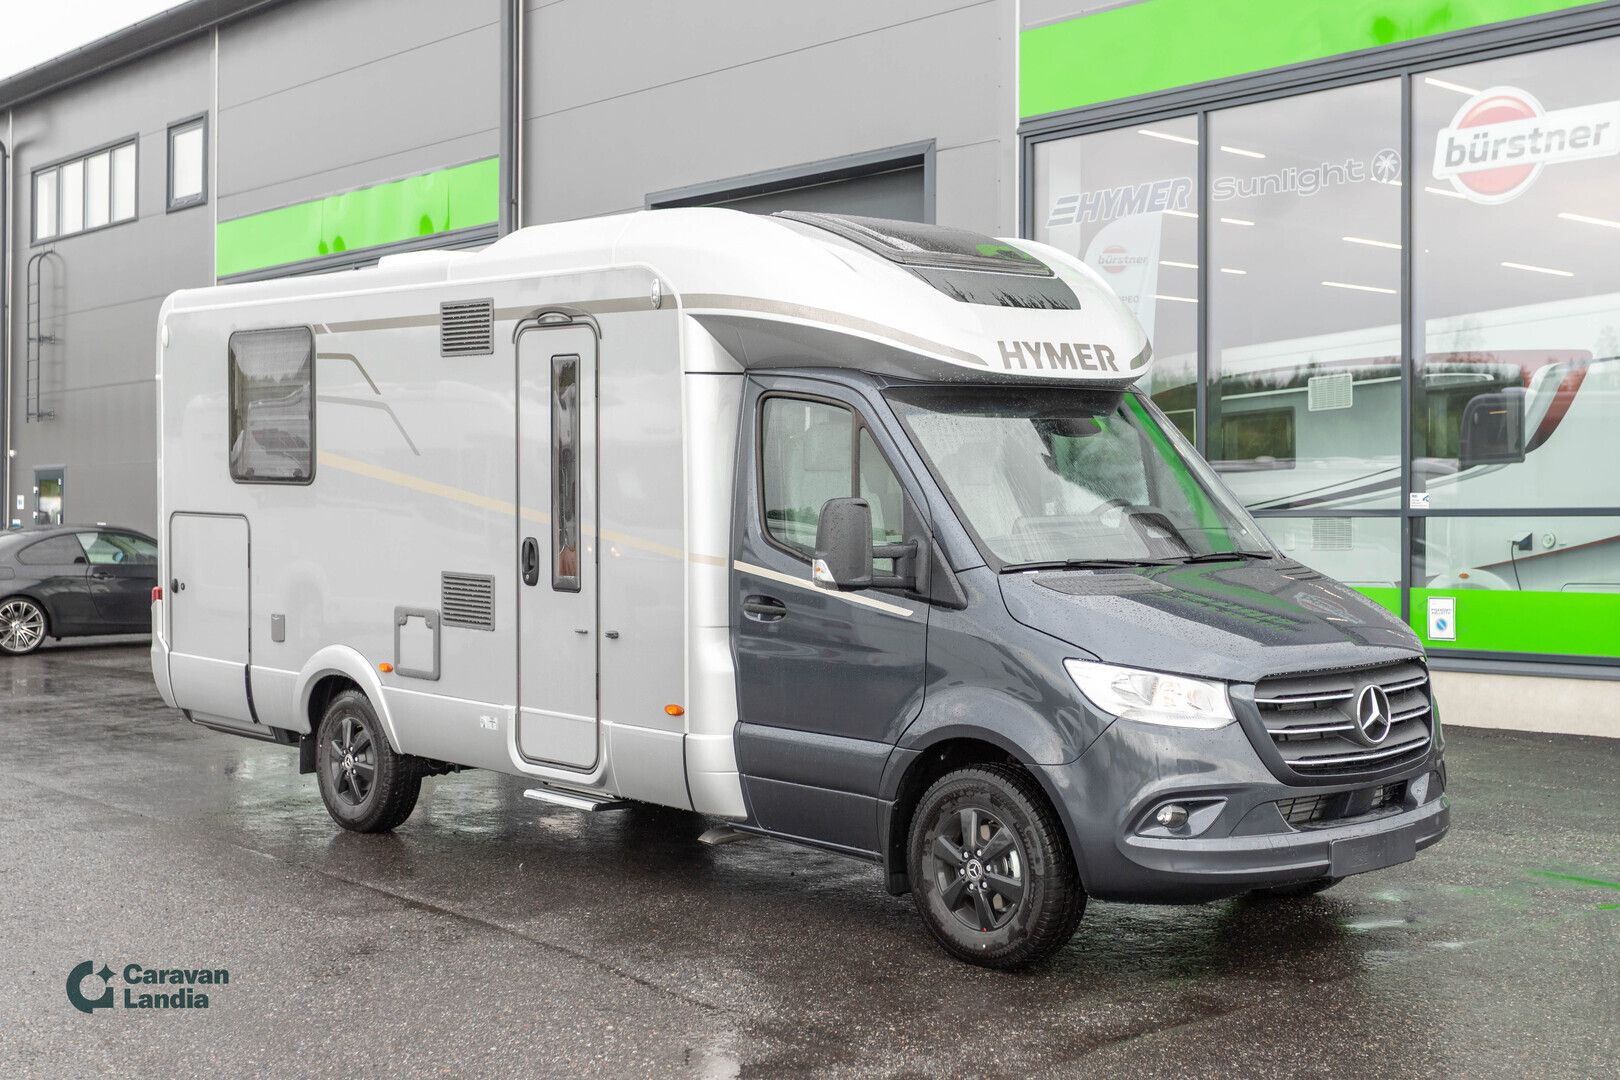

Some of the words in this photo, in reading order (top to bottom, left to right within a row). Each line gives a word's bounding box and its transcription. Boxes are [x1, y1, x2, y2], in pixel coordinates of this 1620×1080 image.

[1445, 119, 1611, 168] bürstner
[1213, 158, 1363, 200] Sunlight
[1075, 177, 1193, 224] HYMER
[1097, 255, 1148, 265] bürstner
[997, 340, 1118, 372] HYMER
